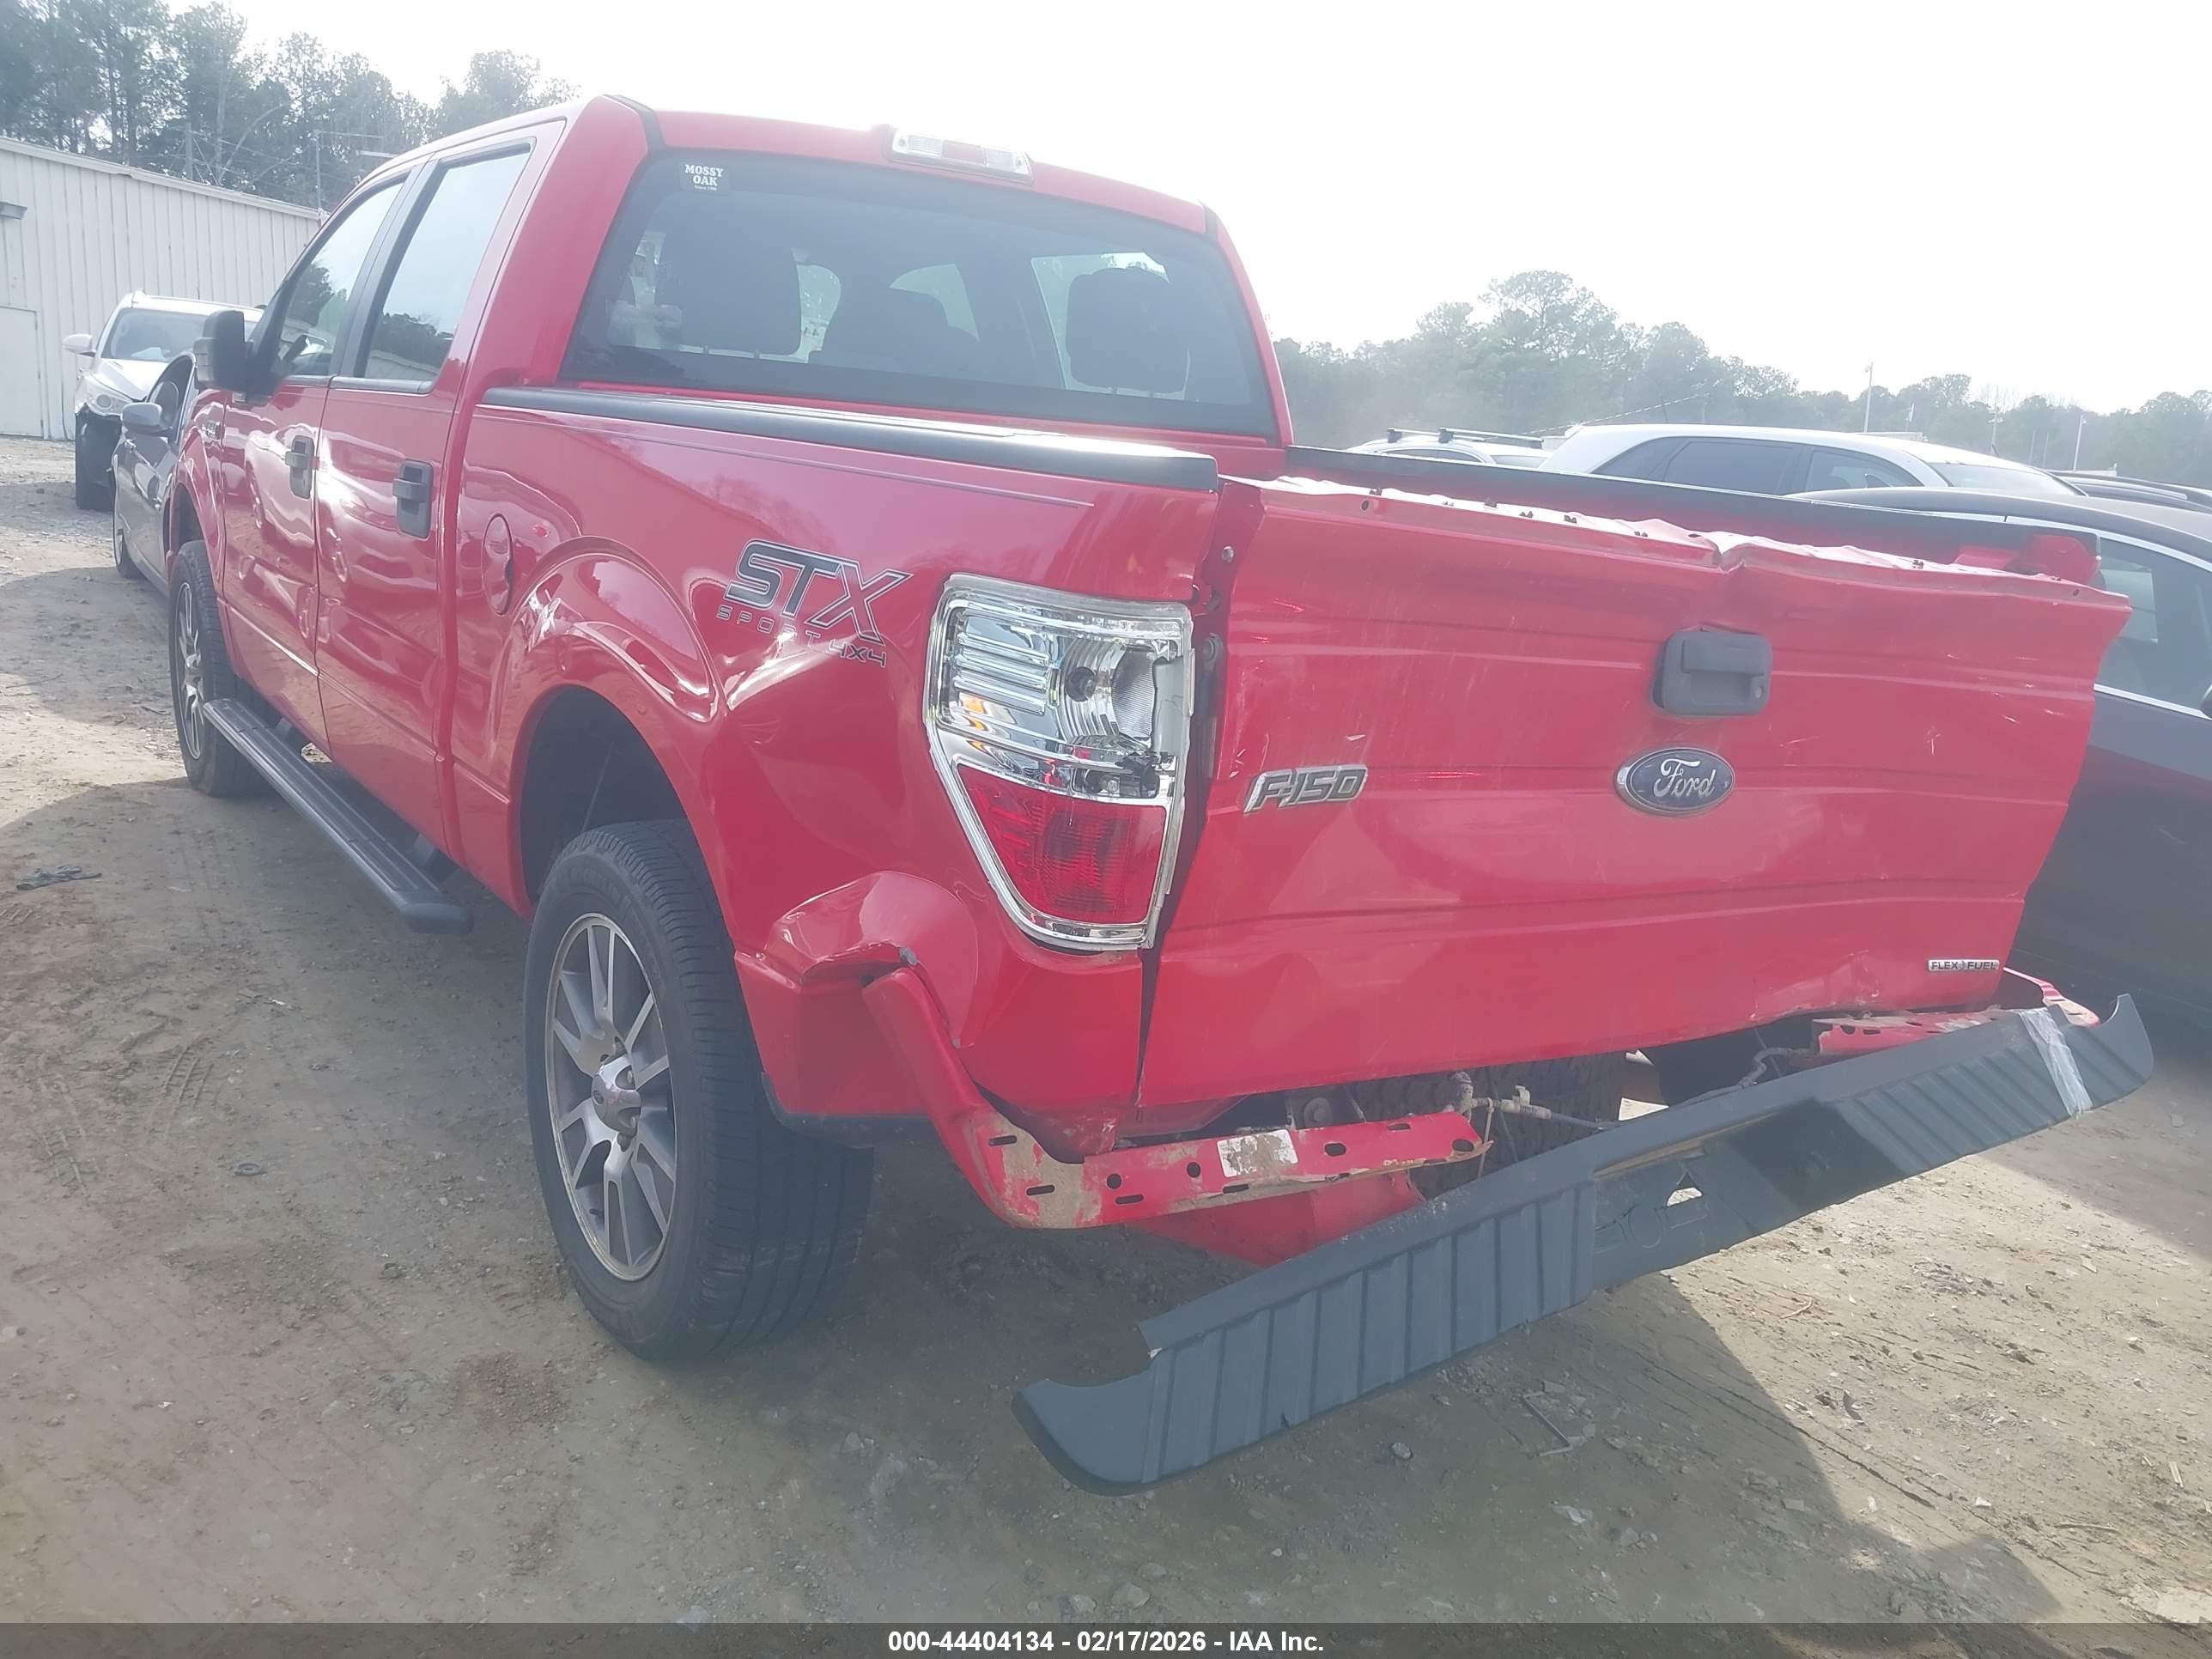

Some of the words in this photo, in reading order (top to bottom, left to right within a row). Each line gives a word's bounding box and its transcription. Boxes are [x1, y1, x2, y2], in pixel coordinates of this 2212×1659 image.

[685, 164, 723, 177] MOSSY
[693, 174, 718, 186] OAK
[723, 538, 914, 646] STX
[1653, 758, 1717, 798] Ford
[1930, 961, 1959, 970] FLEX
[1967, 961, 1998, 970] FUEL
